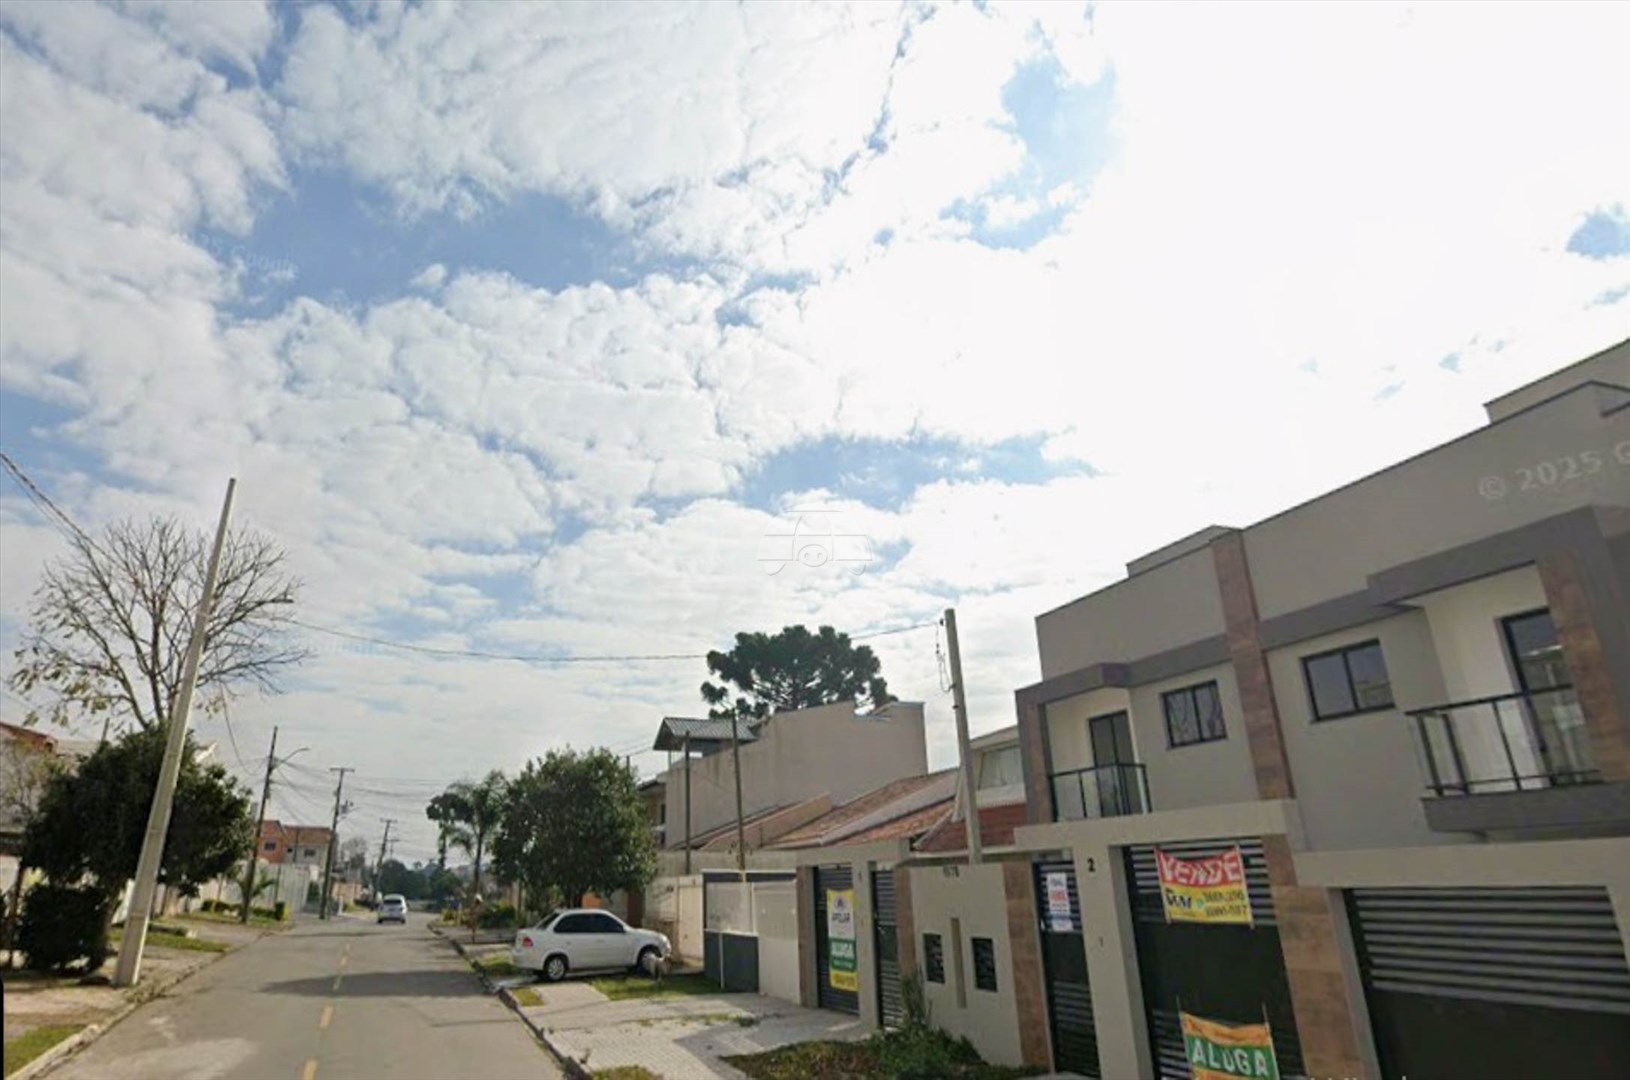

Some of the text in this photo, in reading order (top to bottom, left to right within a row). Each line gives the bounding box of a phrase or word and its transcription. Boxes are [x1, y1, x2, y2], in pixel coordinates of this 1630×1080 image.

[1087, 857, 1096, 873] 2
[1160, 852, 1241, 885] VENDE
[1193, 1039, 1268, 1077] ALUGA
